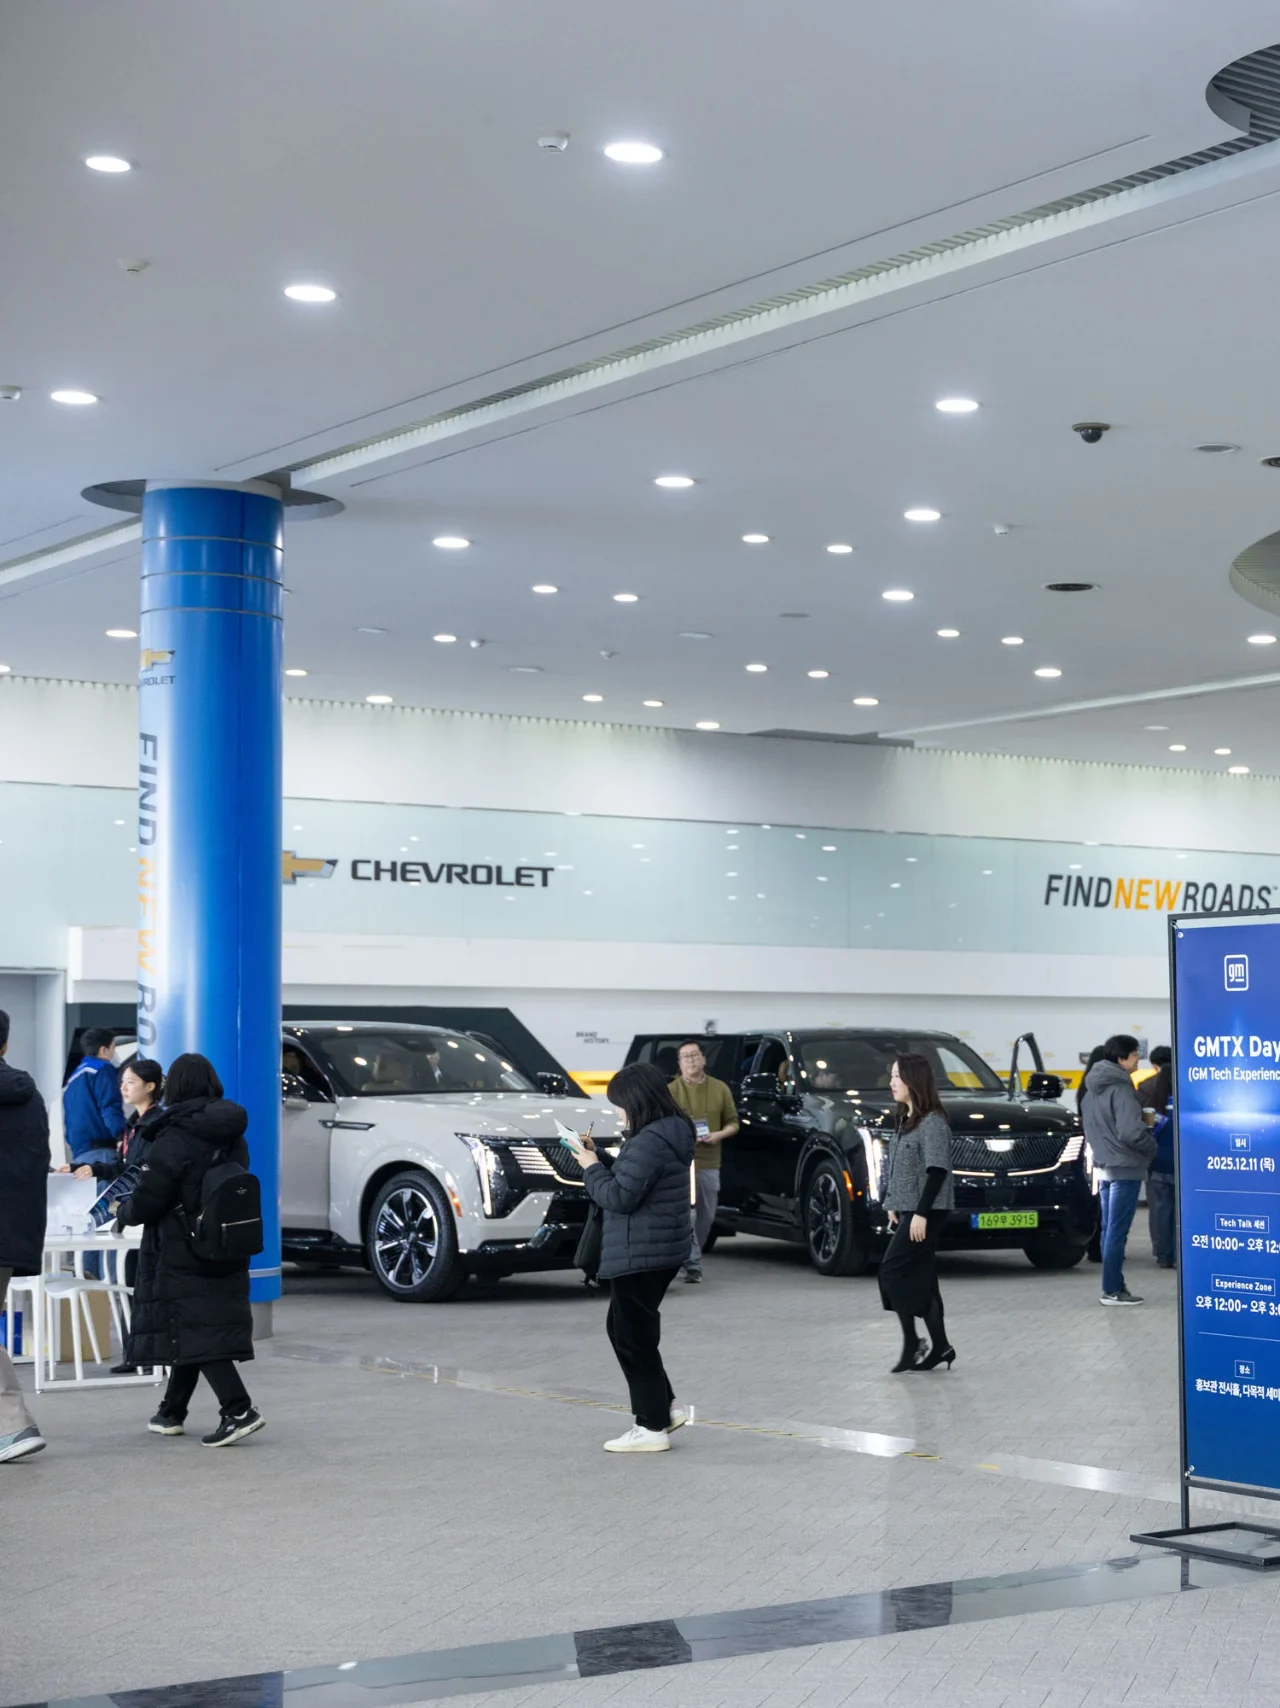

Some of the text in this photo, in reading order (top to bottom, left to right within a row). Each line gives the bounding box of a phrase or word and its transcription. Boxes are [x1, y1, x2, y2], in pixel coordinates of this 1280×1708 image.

[351, 859, 555, 888] CHEVROLET
[1194, 1036, 1244, 1058] GMTX
[1188, 1066, 1208, 1082] (GM
[1209, 1067, 1232, 1081] Tech
[1235, 1137, 1247, 1148] 일시
[1207, 1156, 1275, 1173] 2025.12.11 (목)
[1010, 1213, 1035, 1226] 3915
[1220, 1218, 1236, 1228] Tech
[1238, 1219, 1252, 1228] Talk
[1191, 1235, 1208, 1249] 오전
[1247, 1238, 1263, 1253] 오후
[1215, 1278, 1272, 1292] Experience Zone
[1195, 1295, 1212, 1309] 오후
[1250, 1299, 1267, 1314] 오후
[1239, 1364, 1251, 1375] 장소
[1195, 1378, 1217, 1393] 홍보관
[1243, 1384, 1265, 1399] 다목적
